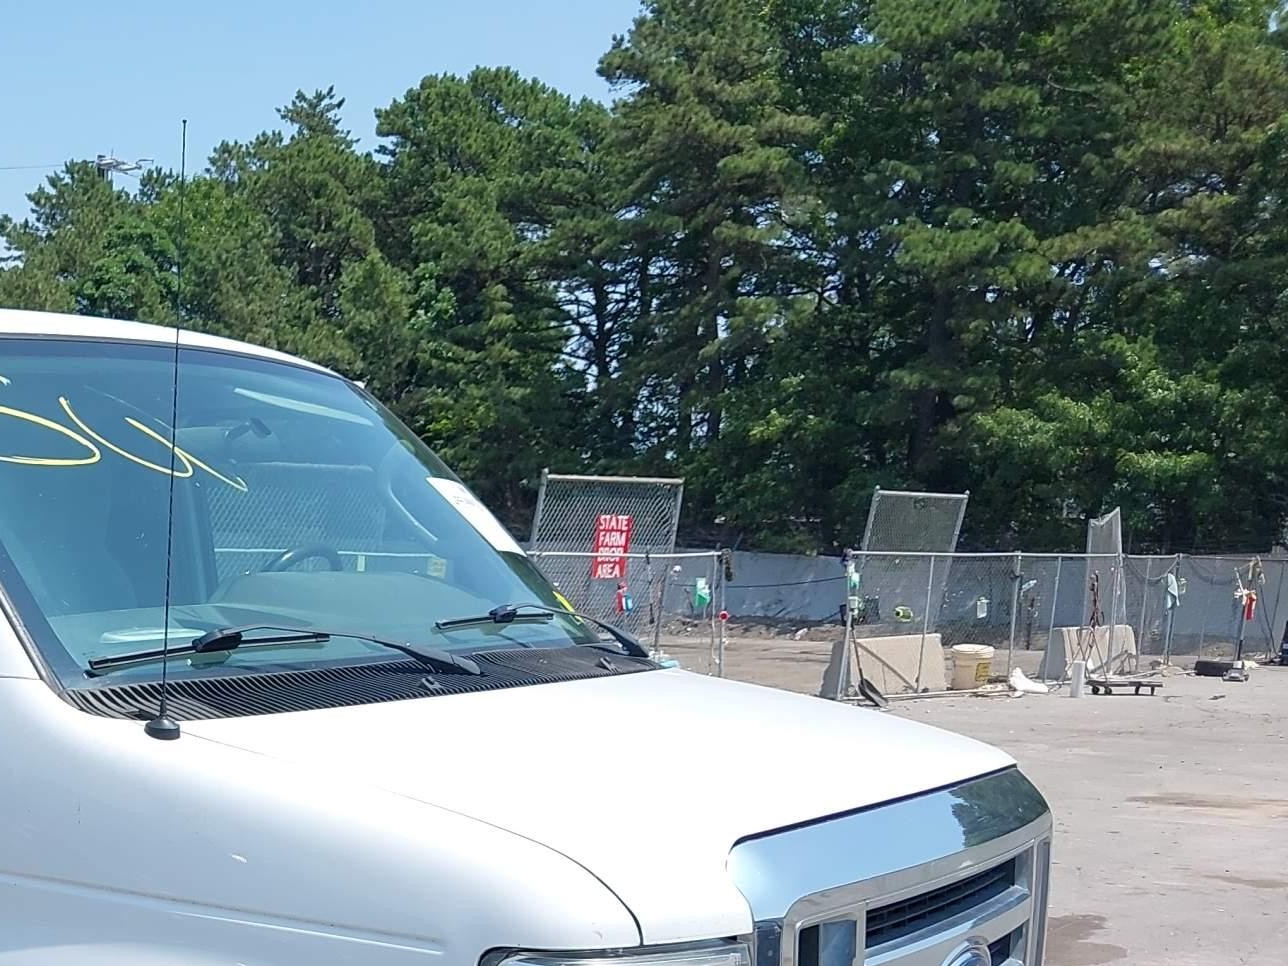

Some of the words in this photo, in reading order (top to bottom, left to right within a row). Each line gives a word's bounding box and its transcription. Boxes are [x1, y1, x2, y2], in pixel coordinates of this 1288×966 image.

[599, 514, 629, 530] STATE
[598, 531, 627, 547] FARM
[595, 563, 621, 579] AREA
